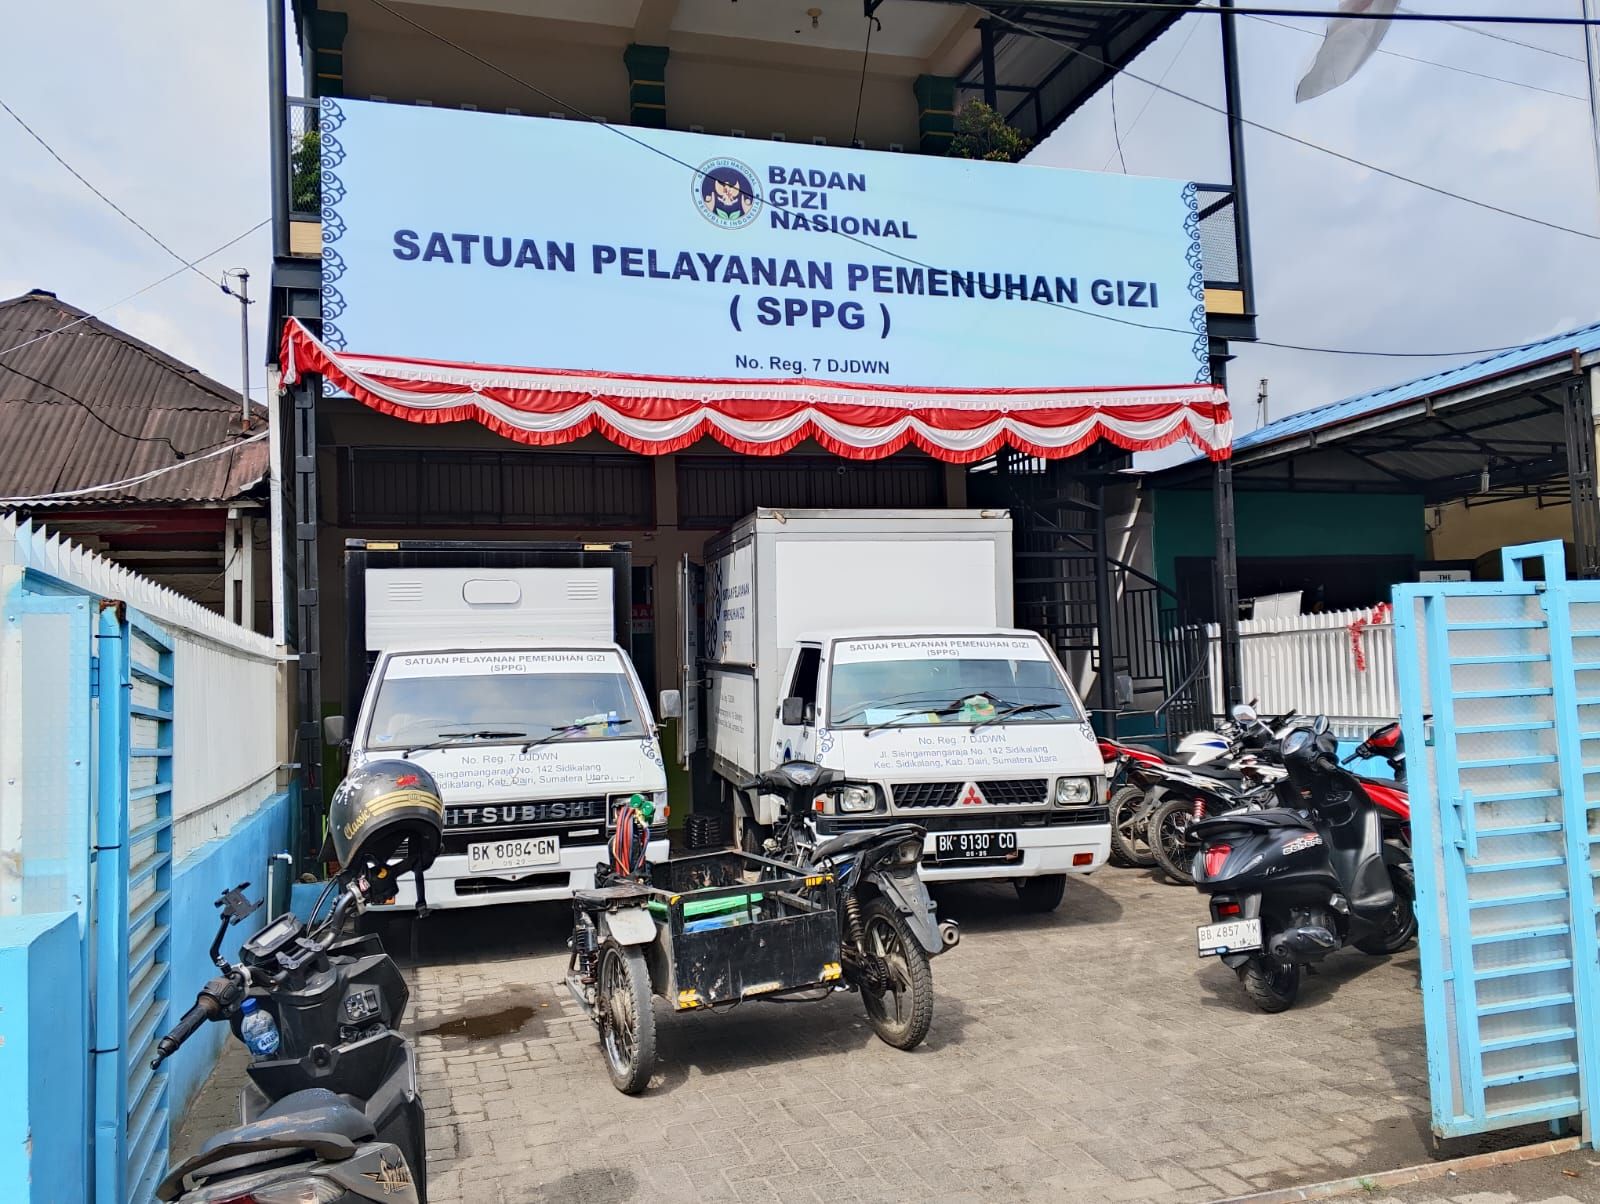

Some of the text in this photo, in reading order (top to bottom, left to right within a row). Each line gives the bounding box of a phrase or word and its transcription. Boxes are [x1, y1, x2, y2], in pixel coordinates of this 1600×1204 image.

[768, 165, 867, 192] BADAN
[769, 188, 828, 210] GIZI
[770, 210, 918, 239] NASIONAL
[392, 229, 1160, 308] SATUAN PELAYANAN PEMENUHAN GIZI
[756, 296, 866, 330] SPPG
[735, 354, 890, 375] No. Reg. 7 DJDWN
[849, 640, 1030, 651] SATUAN PELAYANAN PEMENUHAN GIZI
[926, 649, 960, 657] (SPPG)
[404, 654, 606, 666] SATUAN PELAYANAN PEMENUHAN GIZI
[490, 664, 527, 673] (SPPG)
[918, 736, 935, 745] No.
[961, 735, 968, 744] 7
[970, 734, 1007, 744] DJDWN
[461, 752, 559, 766] No. Reg. 7 DJDWN
[891, 748, 969, 760] Sisingamangaraja
[988, 746, 1004, 755] 142
[1005, 744, 1049, 756] Sidikalang
[517, 766, 534, 775] No.
[536, 764, 553, 774] 142
[555, 763, 602, 774] Sidikalang
[873, 760, 894, 769] Kec.
[895, 758, 944, 770] Sidikalang,
[992, 755, 1034, 765] Sumatera
[1035, 754, 1058, 764] Utara
[437, 779, 487, 790] idikalang,
[539, 774, 583, 784] Sumatera
[343, 808, 372, 840] Classic
[472, 839, 555, 861] BK 8084 GN
[939, 836, 954, 851] BK
[960, 833, 990, 850] 9130
[1200, 922, 1258, 942] BB 4857 YK
